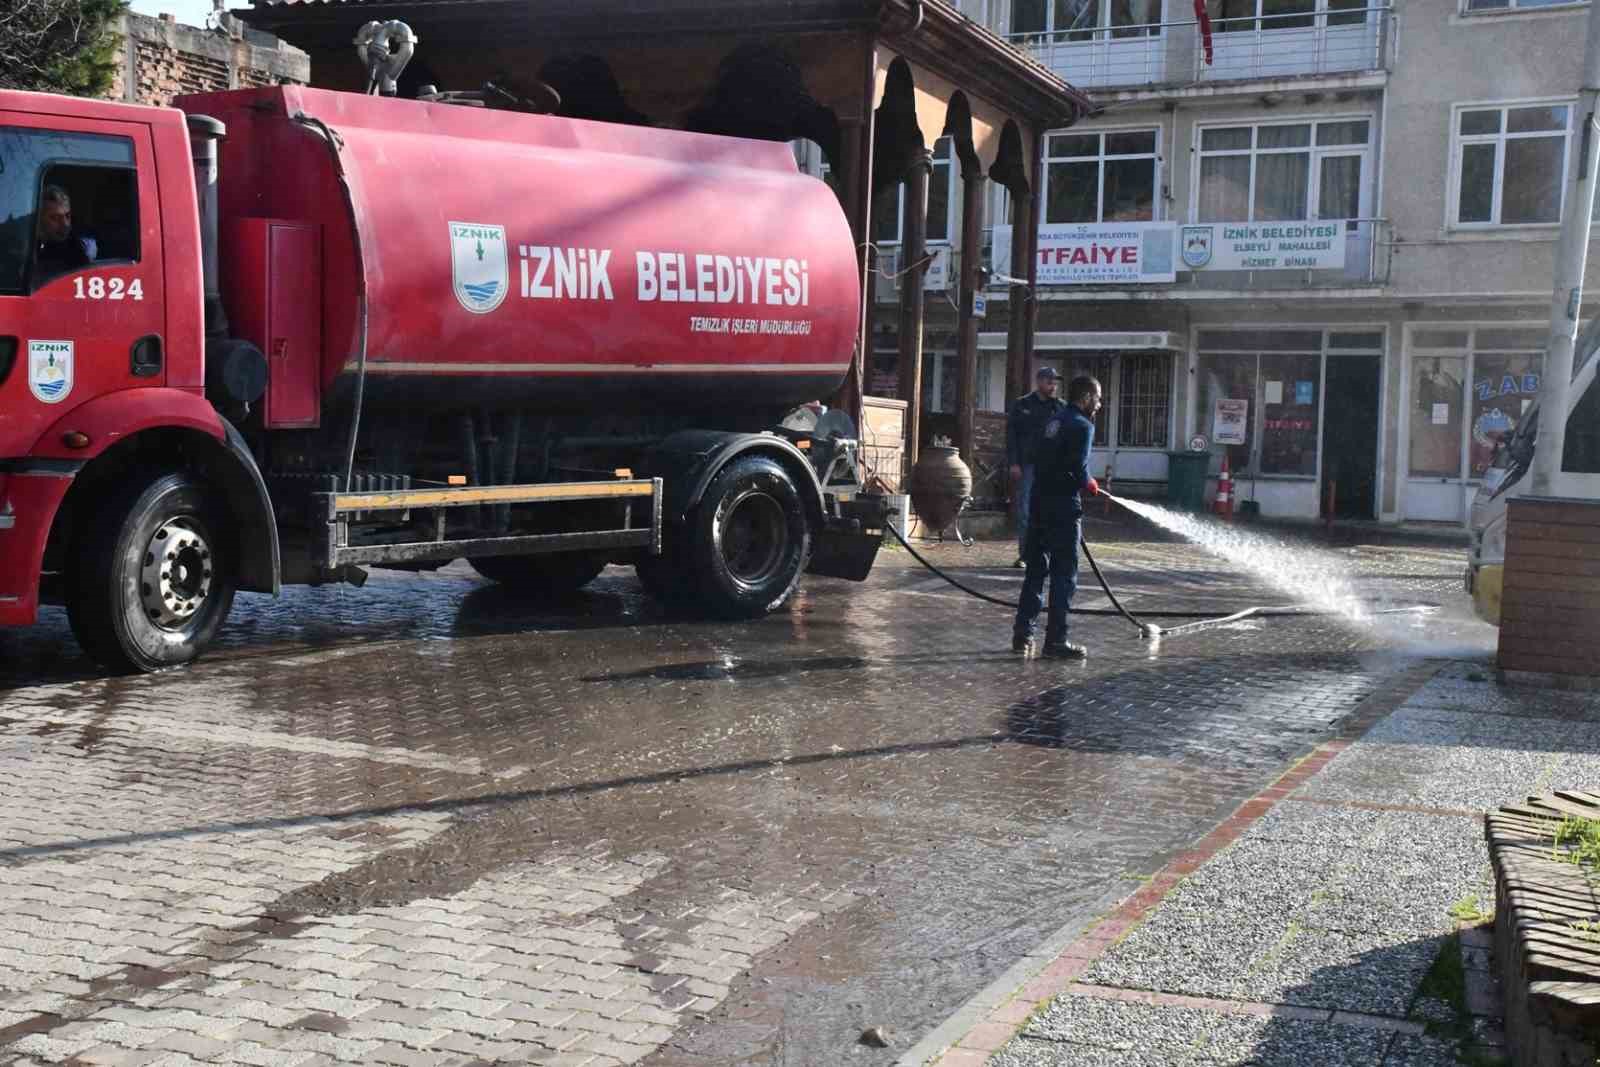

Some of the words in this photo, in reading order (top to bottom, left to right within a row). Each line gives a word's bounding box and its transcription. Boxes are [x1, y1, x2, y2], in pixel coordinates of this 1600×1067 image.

[1223, 225, 1258, 240] İZNİK
[1262, 223, 1337, 239] BELEDİYESİ
[1037, 243, 1138, 265] TFAİYE
[73, 276, 144, 300] 1824
[1473, 373, 1538, 400] ZAB
